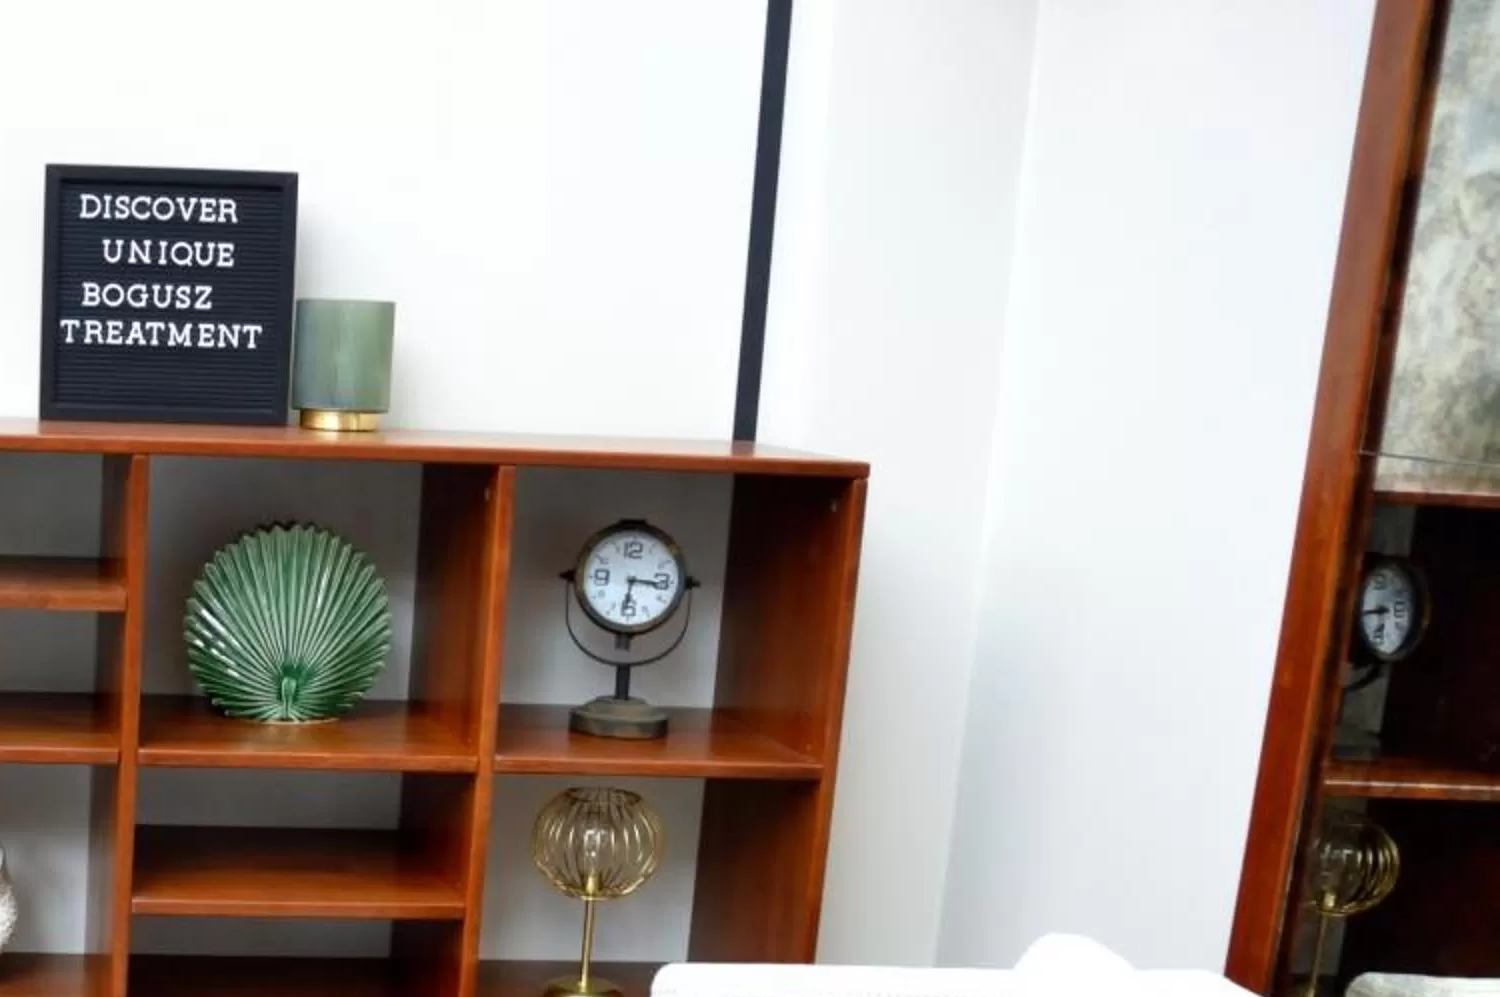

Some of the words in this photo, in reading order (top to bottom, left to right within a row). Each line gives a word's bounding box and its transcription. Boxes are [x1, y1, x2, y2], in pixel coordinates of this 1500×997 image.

[79, 194, 238, 223] DISCOVER
[102, 239, 235, 268] UNIQUE
[81, 282, 213, 310] BOGUSZ
[60, 319, 263, 349] TREATMENT
[623, 541, 643, 560] 12
[594, 568, 610, 587] 9
[654, 572, 670, 591] 3
[620, 599, 637, 617] 6
